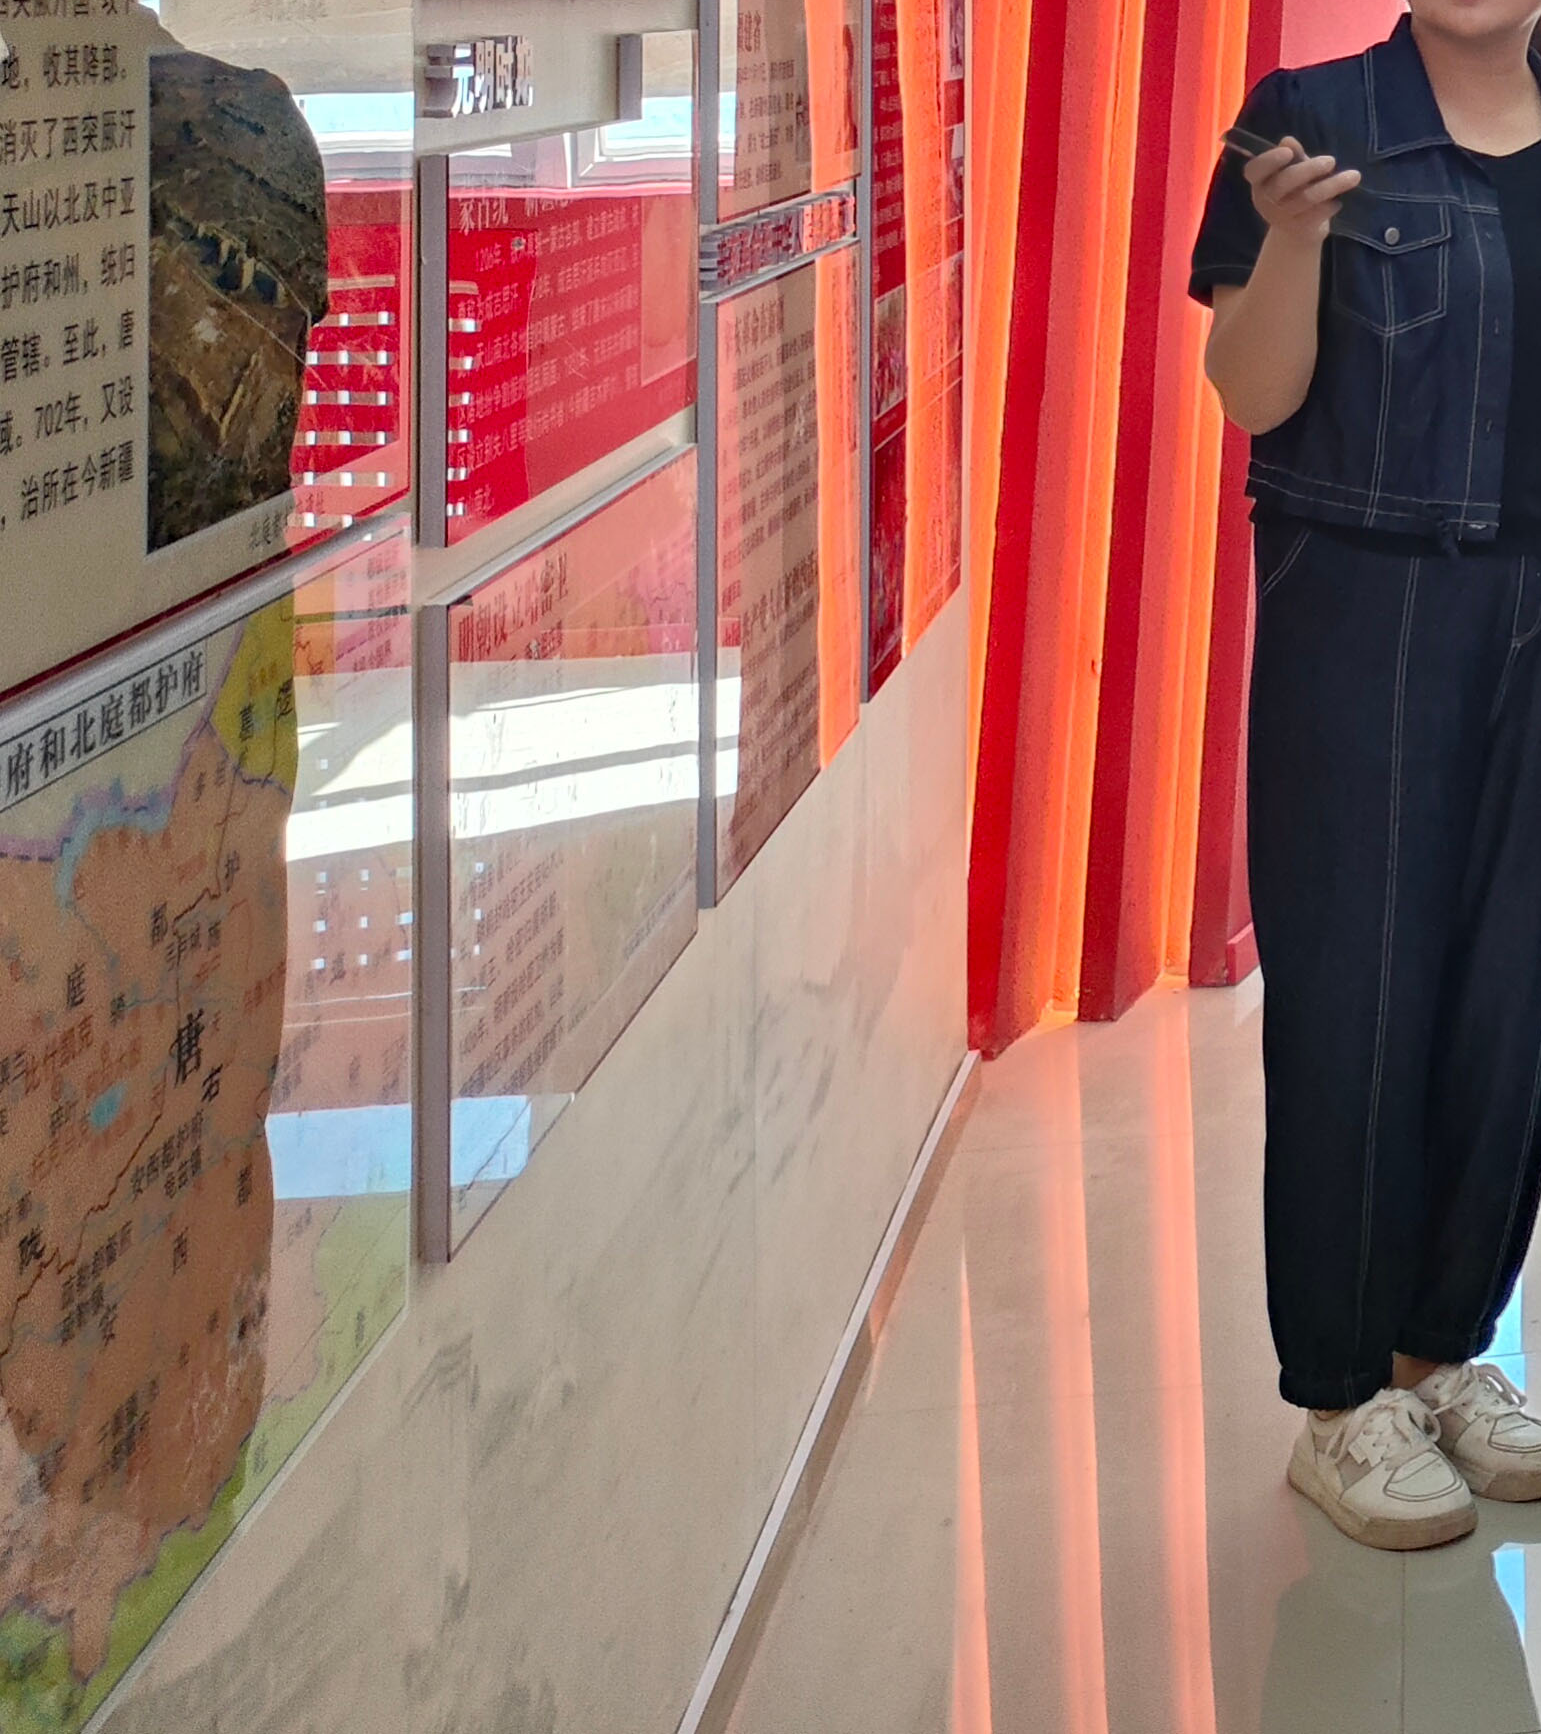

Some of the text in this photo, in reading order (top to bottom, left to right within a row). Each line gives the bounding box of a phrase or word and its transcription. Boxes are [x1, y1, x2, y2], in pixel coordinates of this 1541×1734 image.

[450, 34, 534, 119] 元明时期
[0, 109, 136, 165] 消灭了西突厥汗
[1, 177, 136, 238] 天山以北及中亚
[1, 242, 136, 310] 护府和州，统归
[1, 309, 135, 384] 管辖。至此，唐
